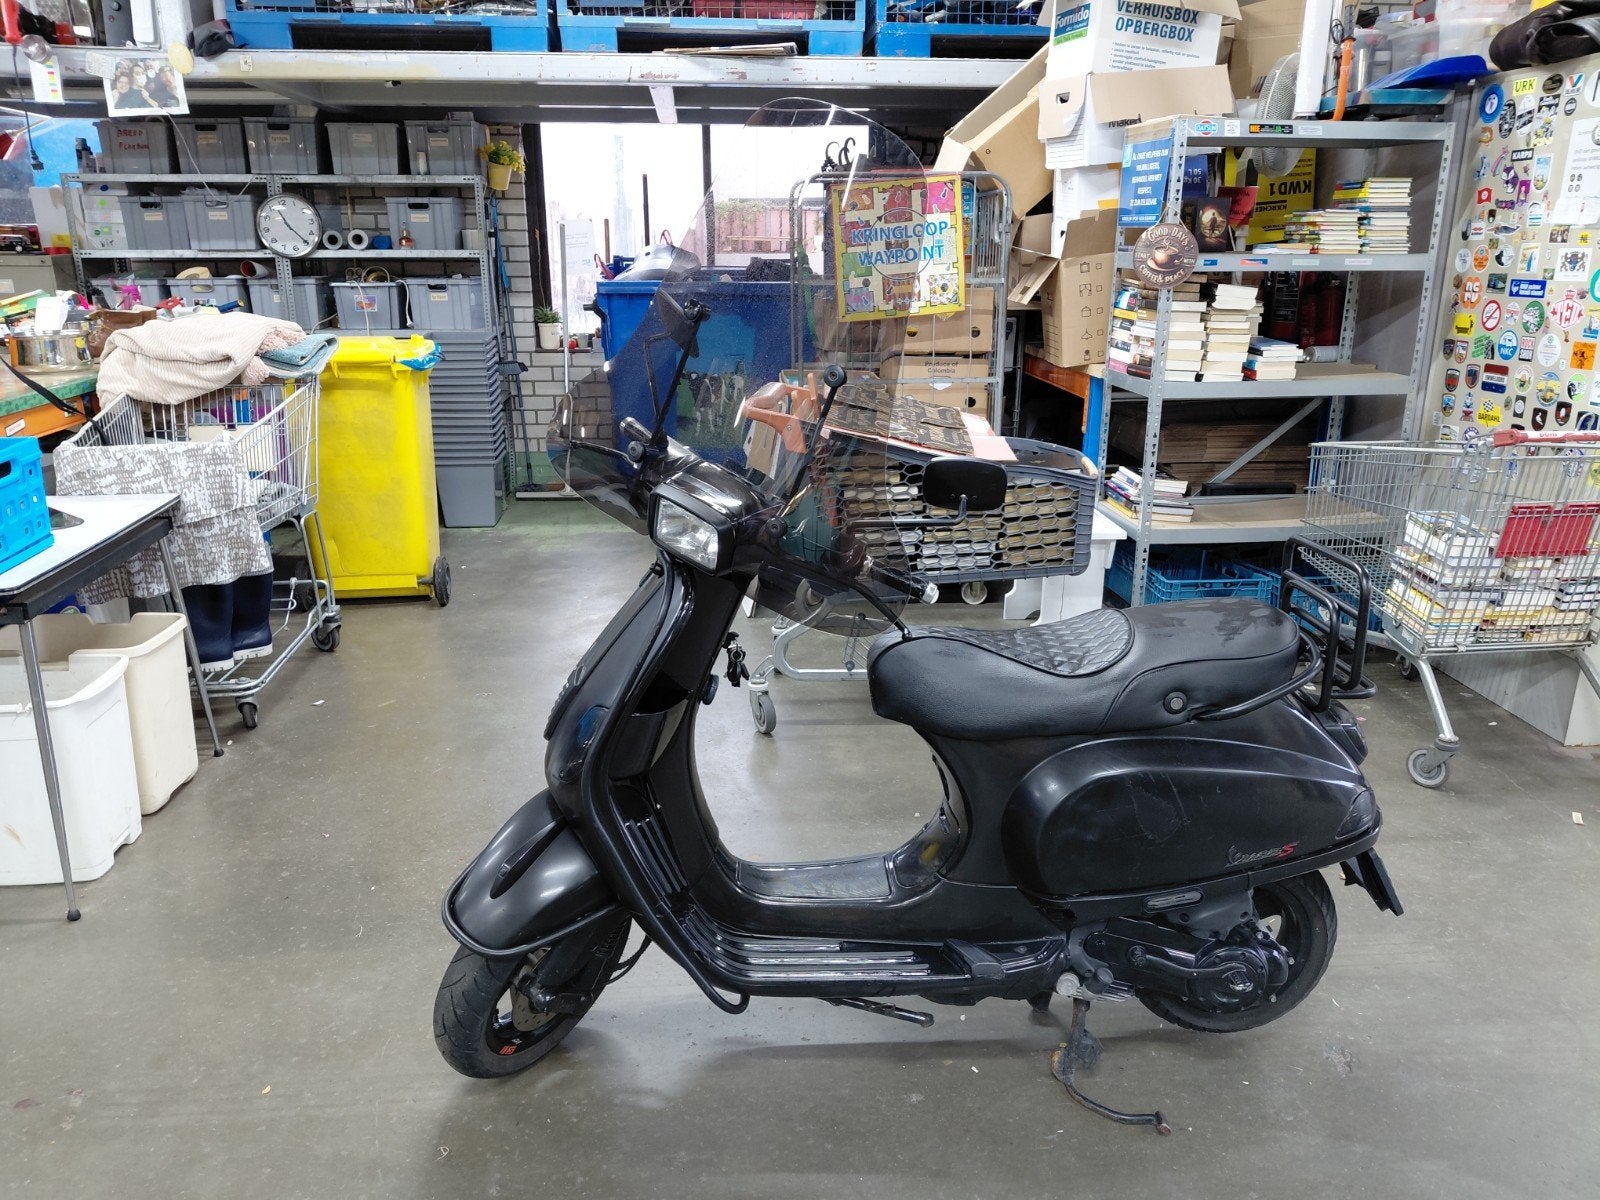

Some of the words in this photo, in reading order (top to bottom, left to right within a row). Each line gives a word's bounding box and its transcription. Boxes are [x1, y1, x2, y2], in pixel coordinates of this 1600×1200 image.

[1056, 7, 1089, 29] Formido
[1117, 0, 1200, 25] VERHUISBOX
[1115, 17, 1195, 42] OPBERGBOX
[1514, 79, 1537, 93] URK
[1269, 182, 1276, 196] 1
[1278, 179, 1312, 196] KWD
[851, 220, 949, 244] KRINGLOOP
[1147, 227, 1169, 241] GOOD
[1171, 227, 1190, 246] DAYS
[859, 244, 945, 267] WAYPONT
[1164, 268, 1185, 283] PEACE
[1500, 347, 1514, 356] NKC
[927, 366, 956, 375] Colombia
[1477, 412, 1501, 423] BARDAHL
